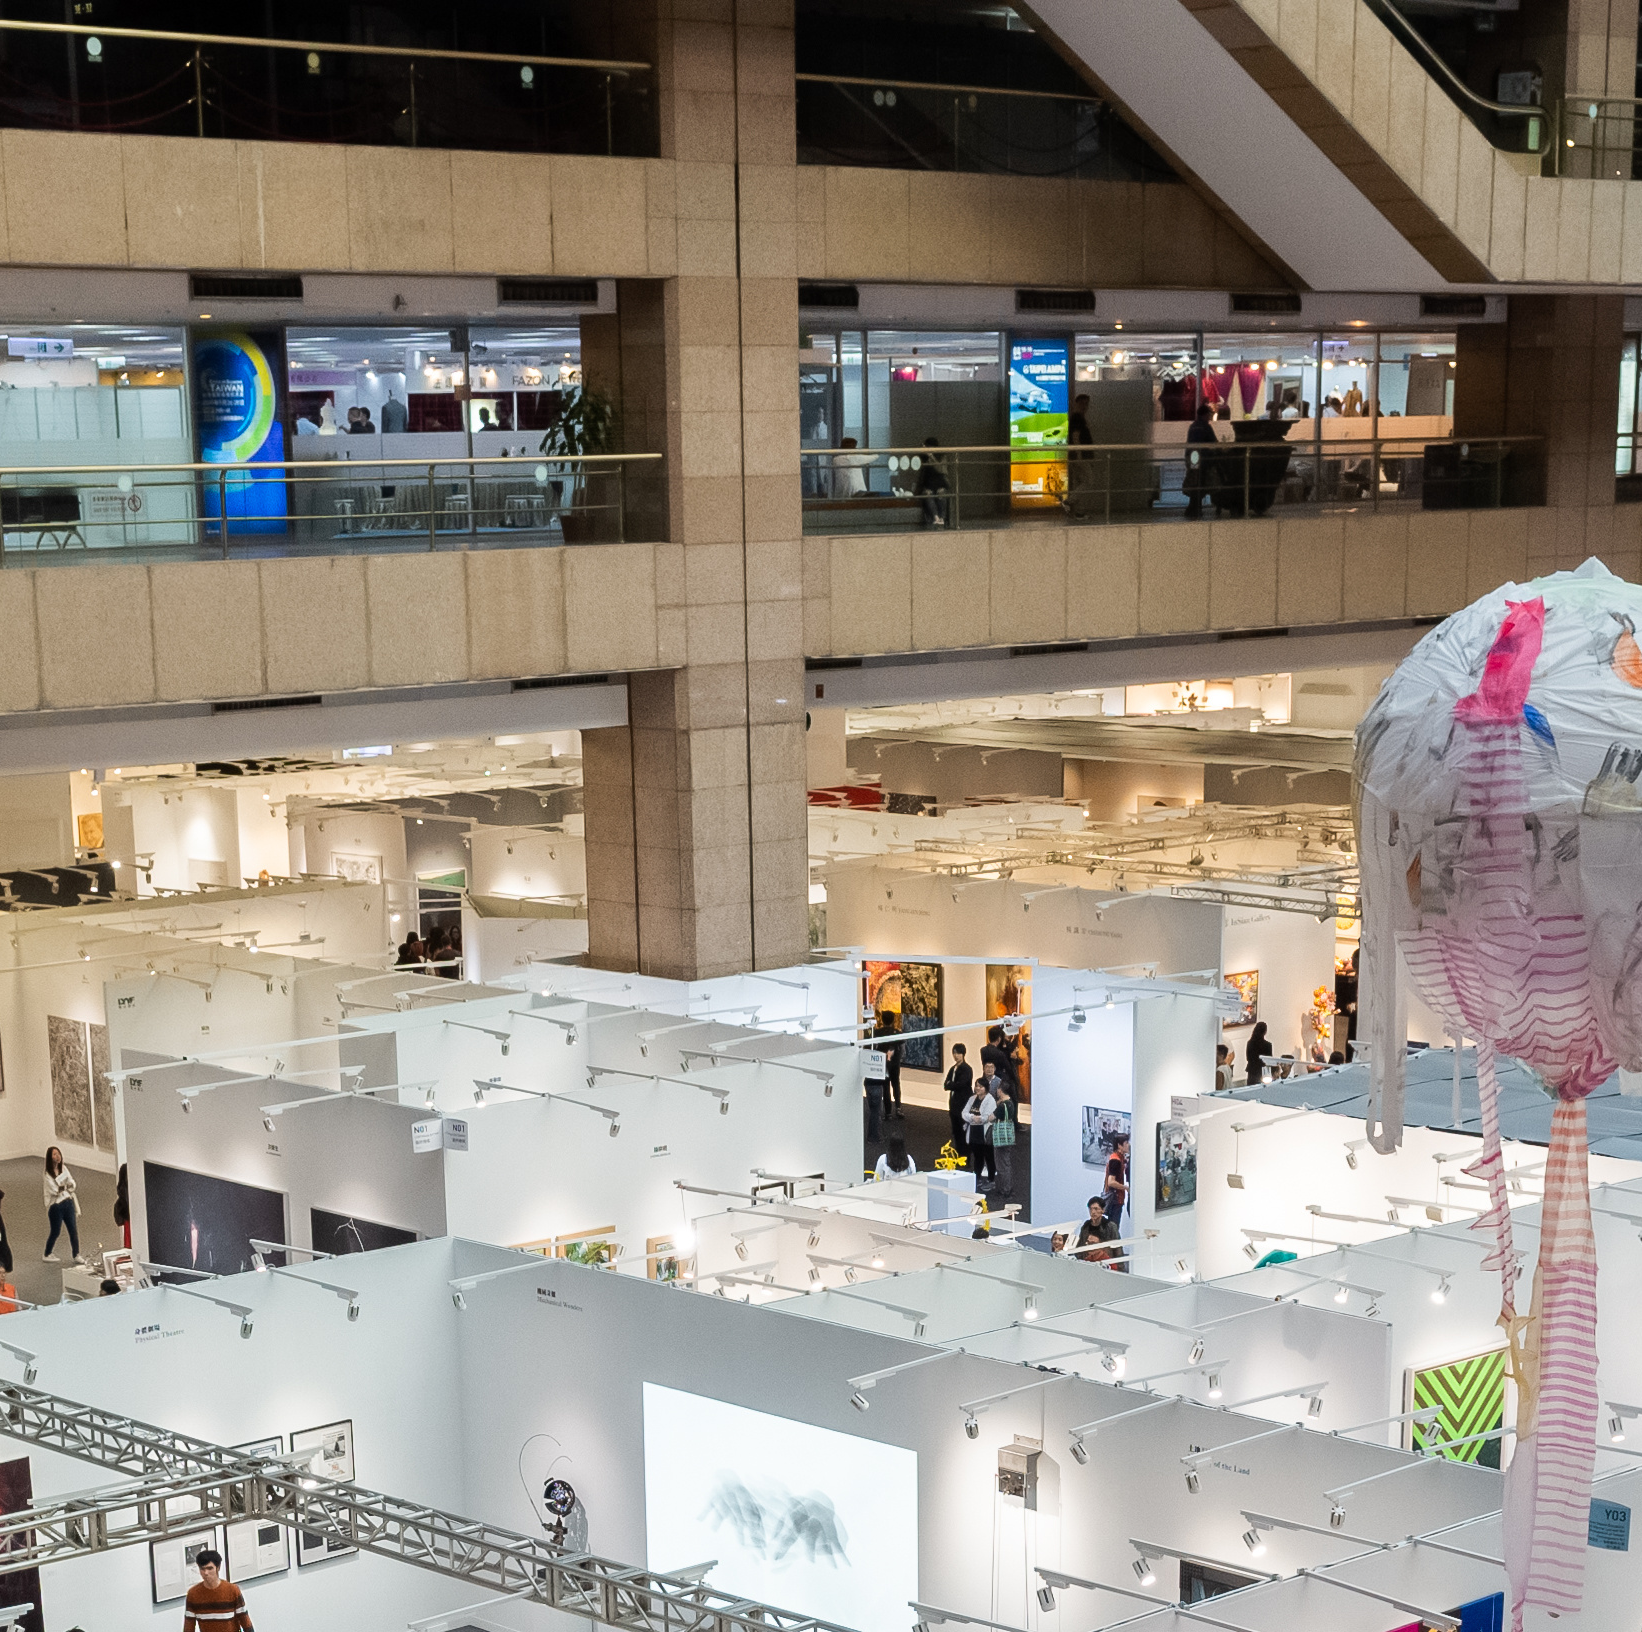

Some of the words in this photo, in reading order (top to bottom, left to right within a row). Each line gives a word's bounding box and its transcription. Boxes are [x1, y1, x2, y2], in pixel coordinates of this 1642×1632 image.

[512, 374, 550, 386] FAZON
[414, 1126, 428, 1134] N01
[452, 1124, 465, 1132] N01
[1605, 1509, 1627, 1522] Y03
